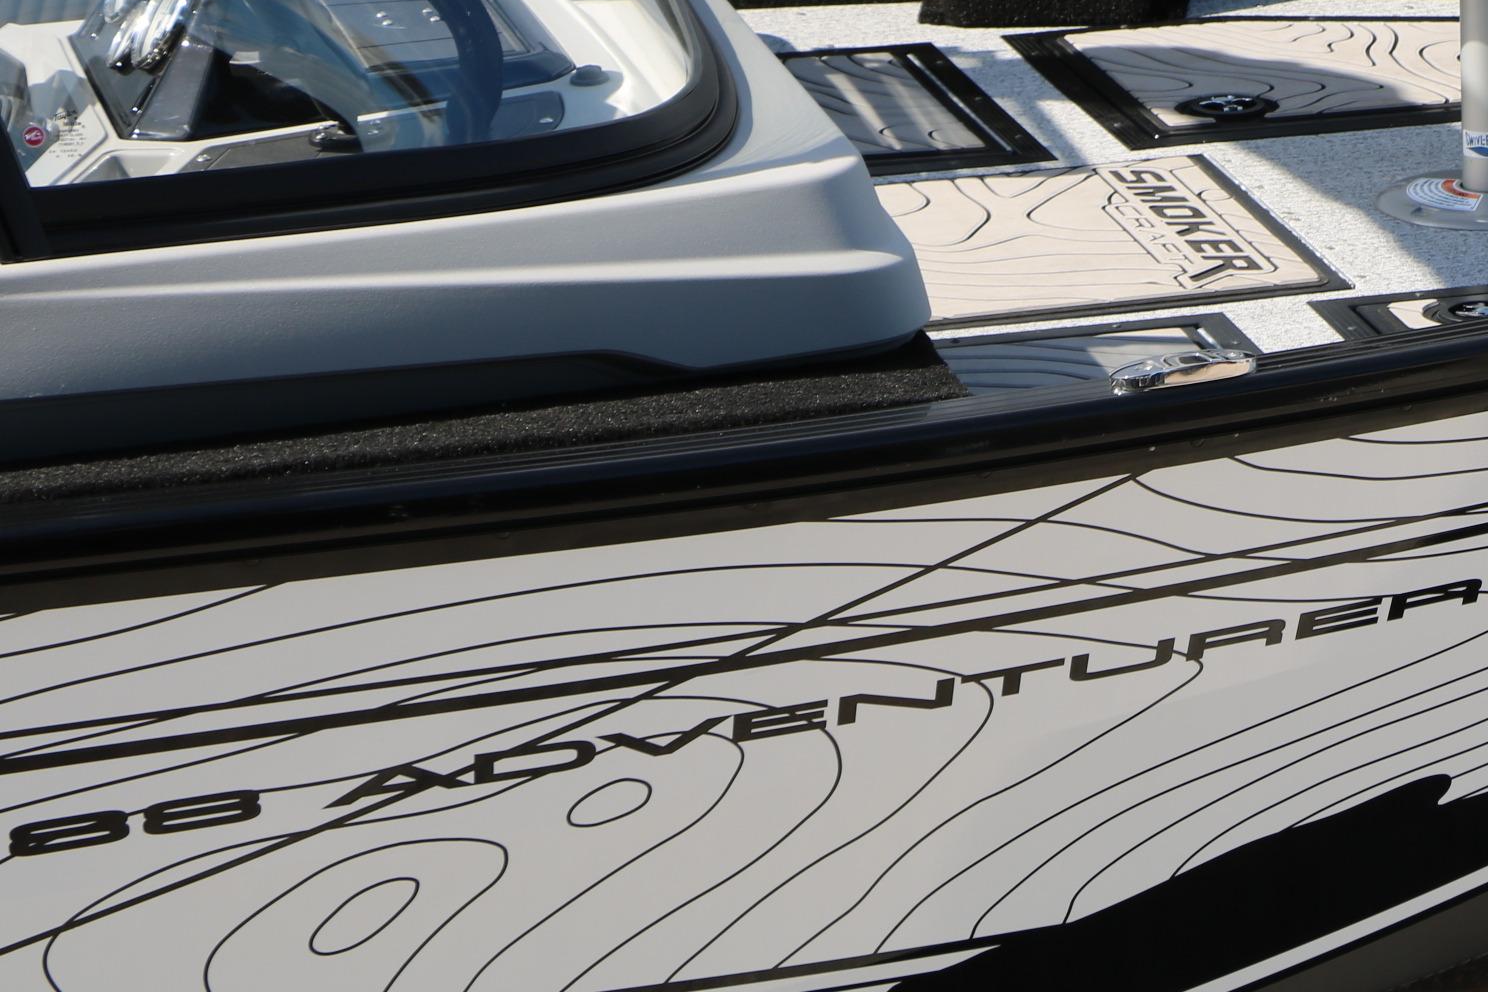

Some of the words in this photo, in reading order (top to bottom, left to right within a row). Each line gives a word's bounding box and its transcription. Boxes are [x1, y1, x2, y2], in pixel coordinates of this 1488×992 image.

[1109, 169, 1264, 283] SMOKER
[1115, 205, 1194, 265] CRAFT
[322, 578, 1482, 810] ADVENTURER
